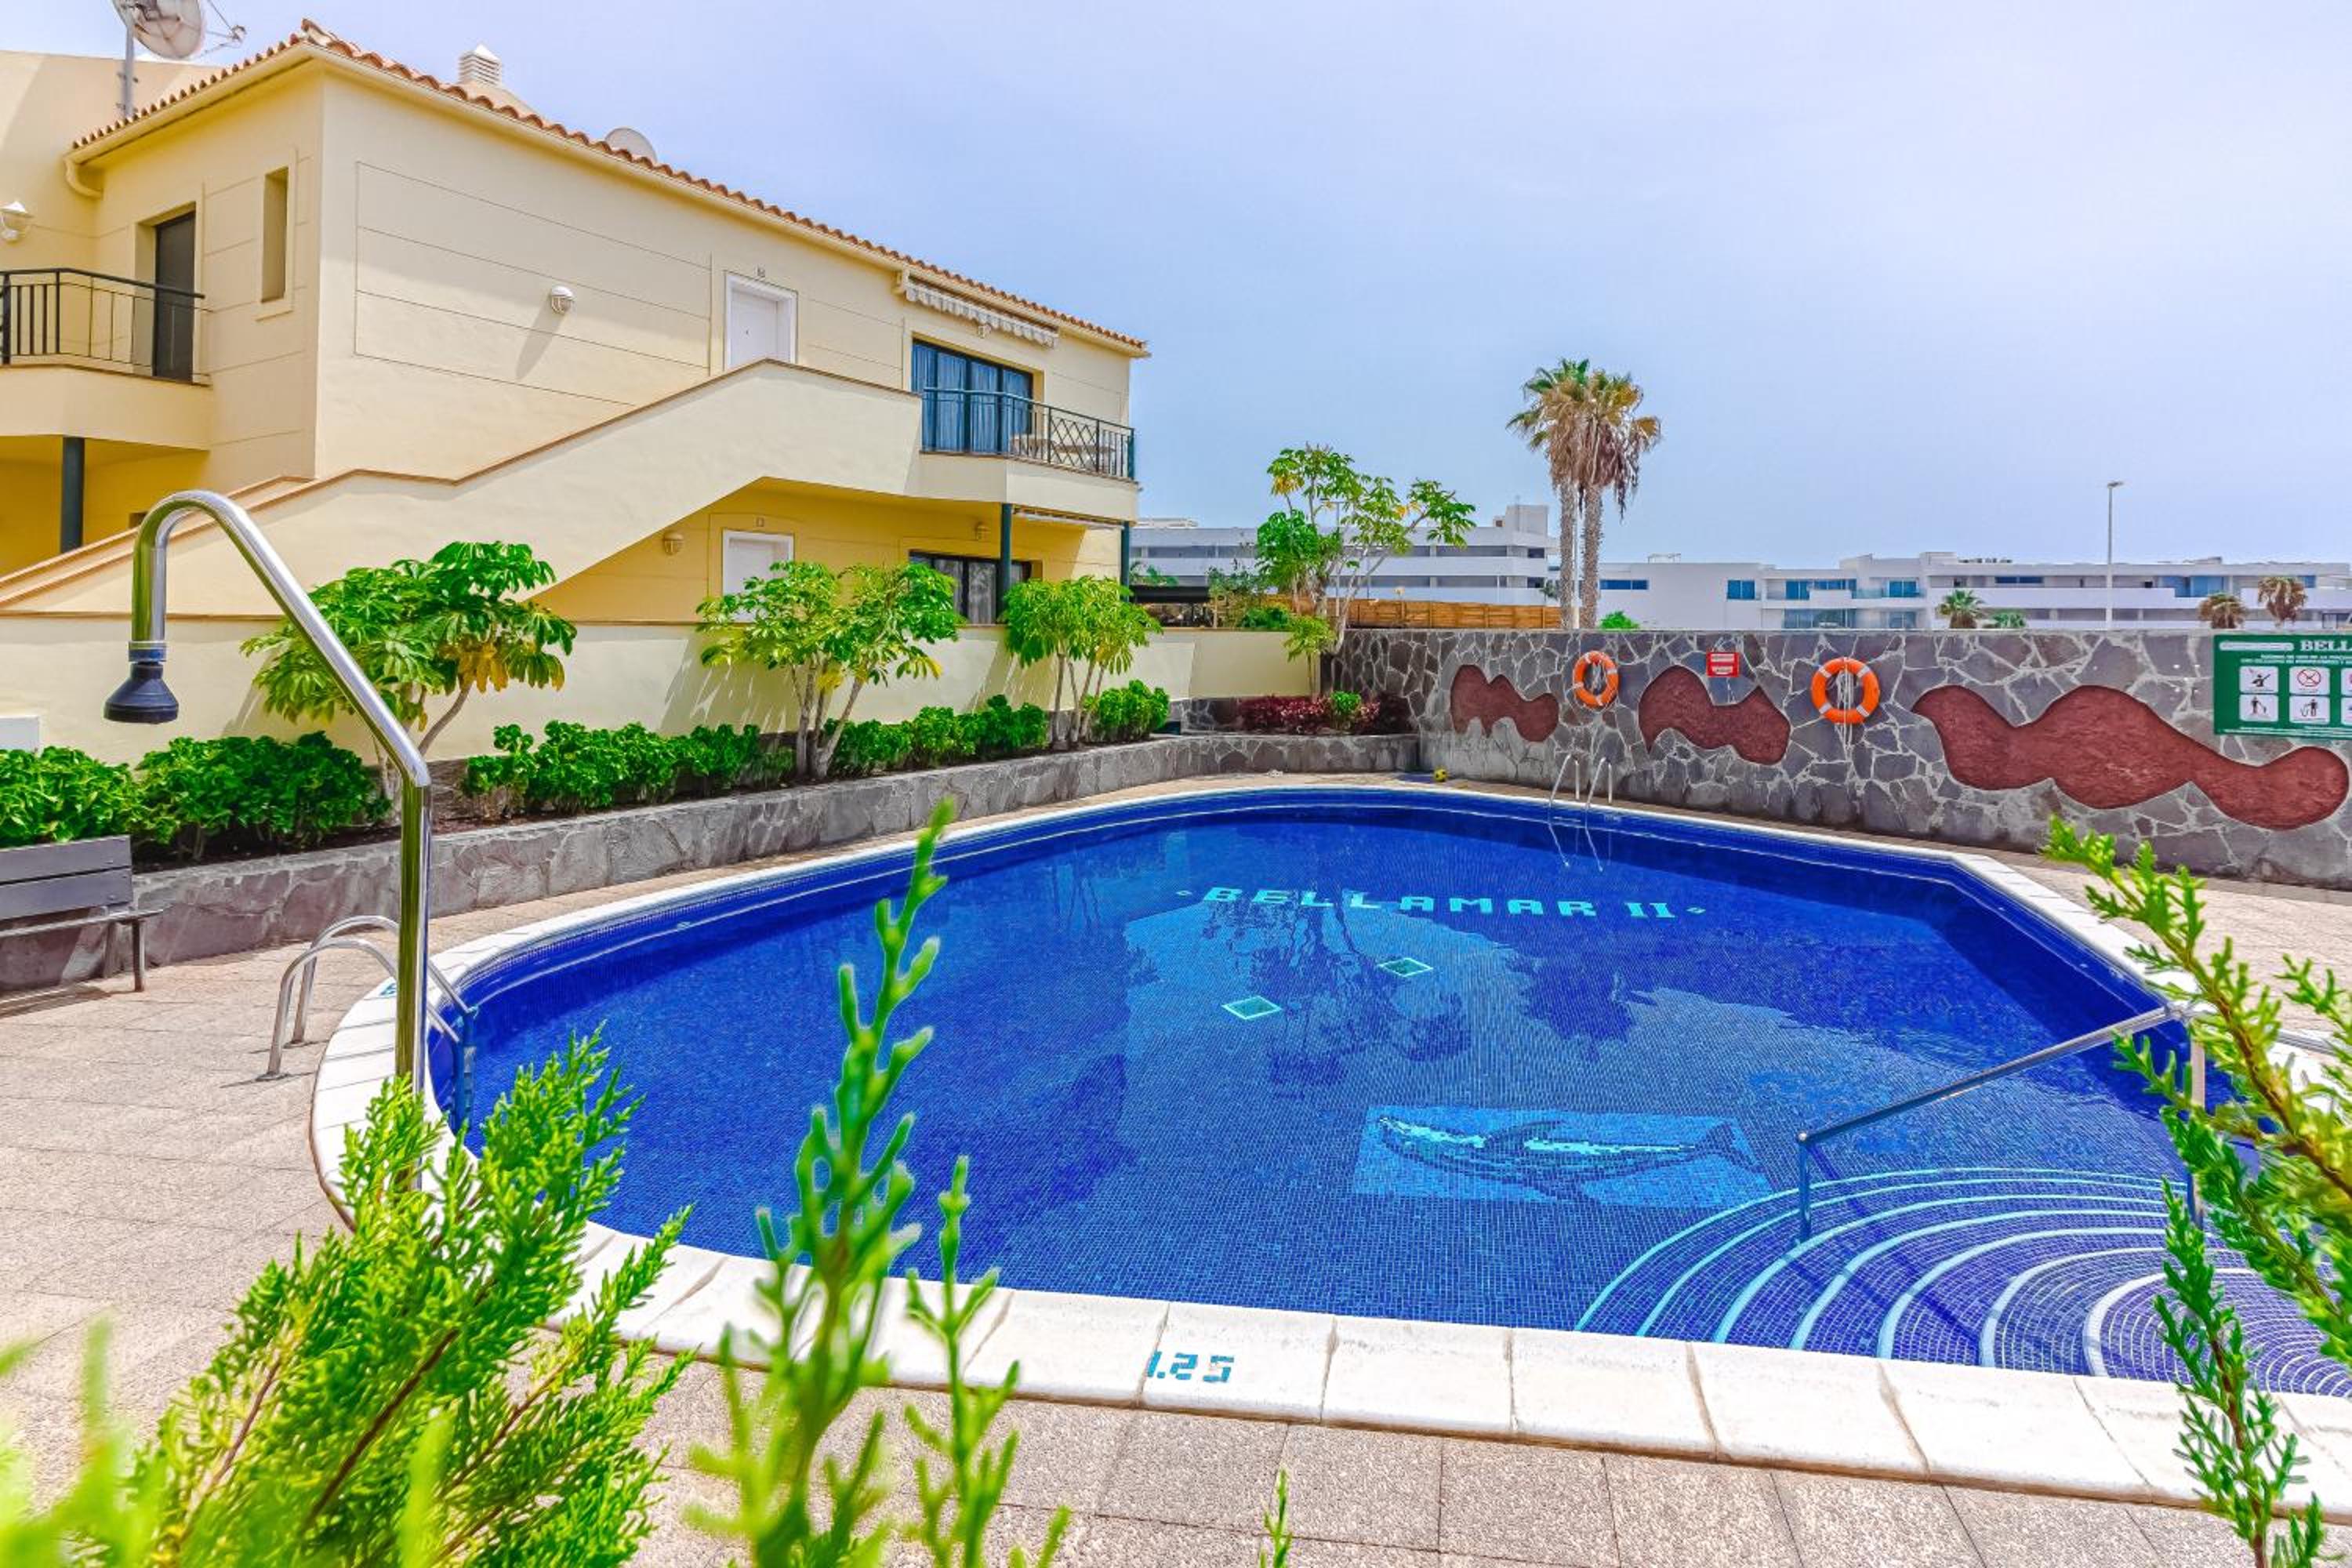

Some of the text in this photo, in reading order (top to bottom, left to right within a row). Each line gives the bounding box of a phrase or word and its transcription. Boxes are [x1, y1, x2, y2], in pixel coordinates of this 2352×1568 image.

[1202, 887, 1675, 918] BELLAMAR II
[1145, 1349, 1234, 1383] 1.25
